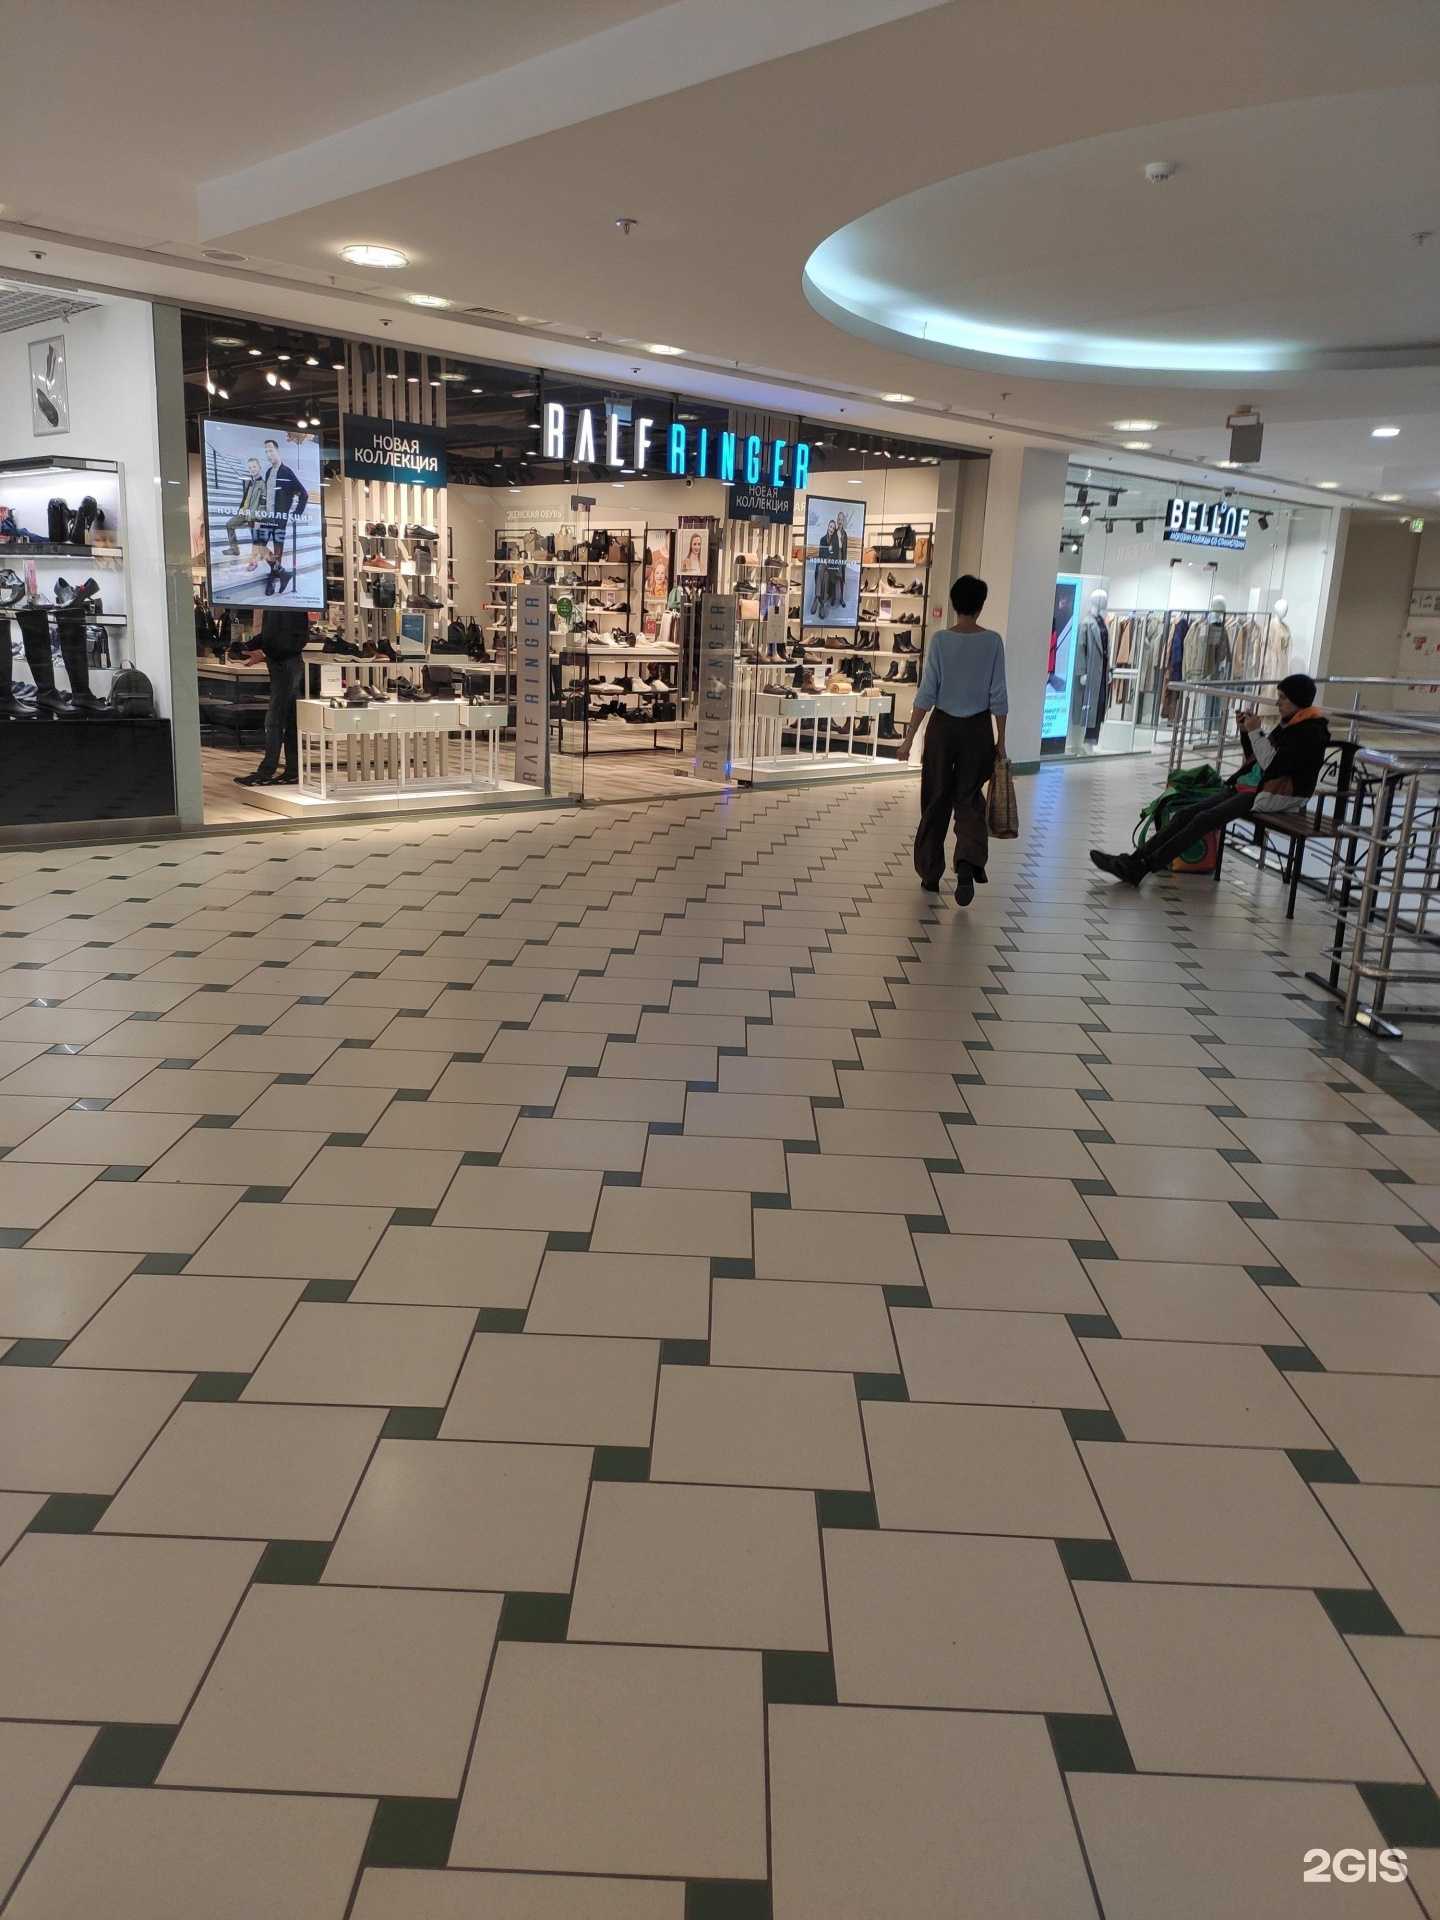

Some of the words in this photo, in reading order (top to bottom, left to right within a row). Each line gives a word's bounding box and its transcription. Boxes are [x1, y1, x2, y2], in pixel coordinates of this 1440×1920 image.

[354, 447, 438, 473] КОЛЛЕКЦИЯ
[373, 434, 420, 454] НОВАЯ
[545, 402, 654, 469] RALF
[669, 423, 811, 490] RINGER
[217, 506, 251, 517] НОВАЯ
[254, 510, 313, 521] КОЛЛЕКЦИЯ
[736, 495, 789, 514] КОЛЛЕКЦИЯ
[525, 597, 540, 705] RINGER
[523, 717, 539, 783] RALF
[703, 711, 720, 771] RALF
